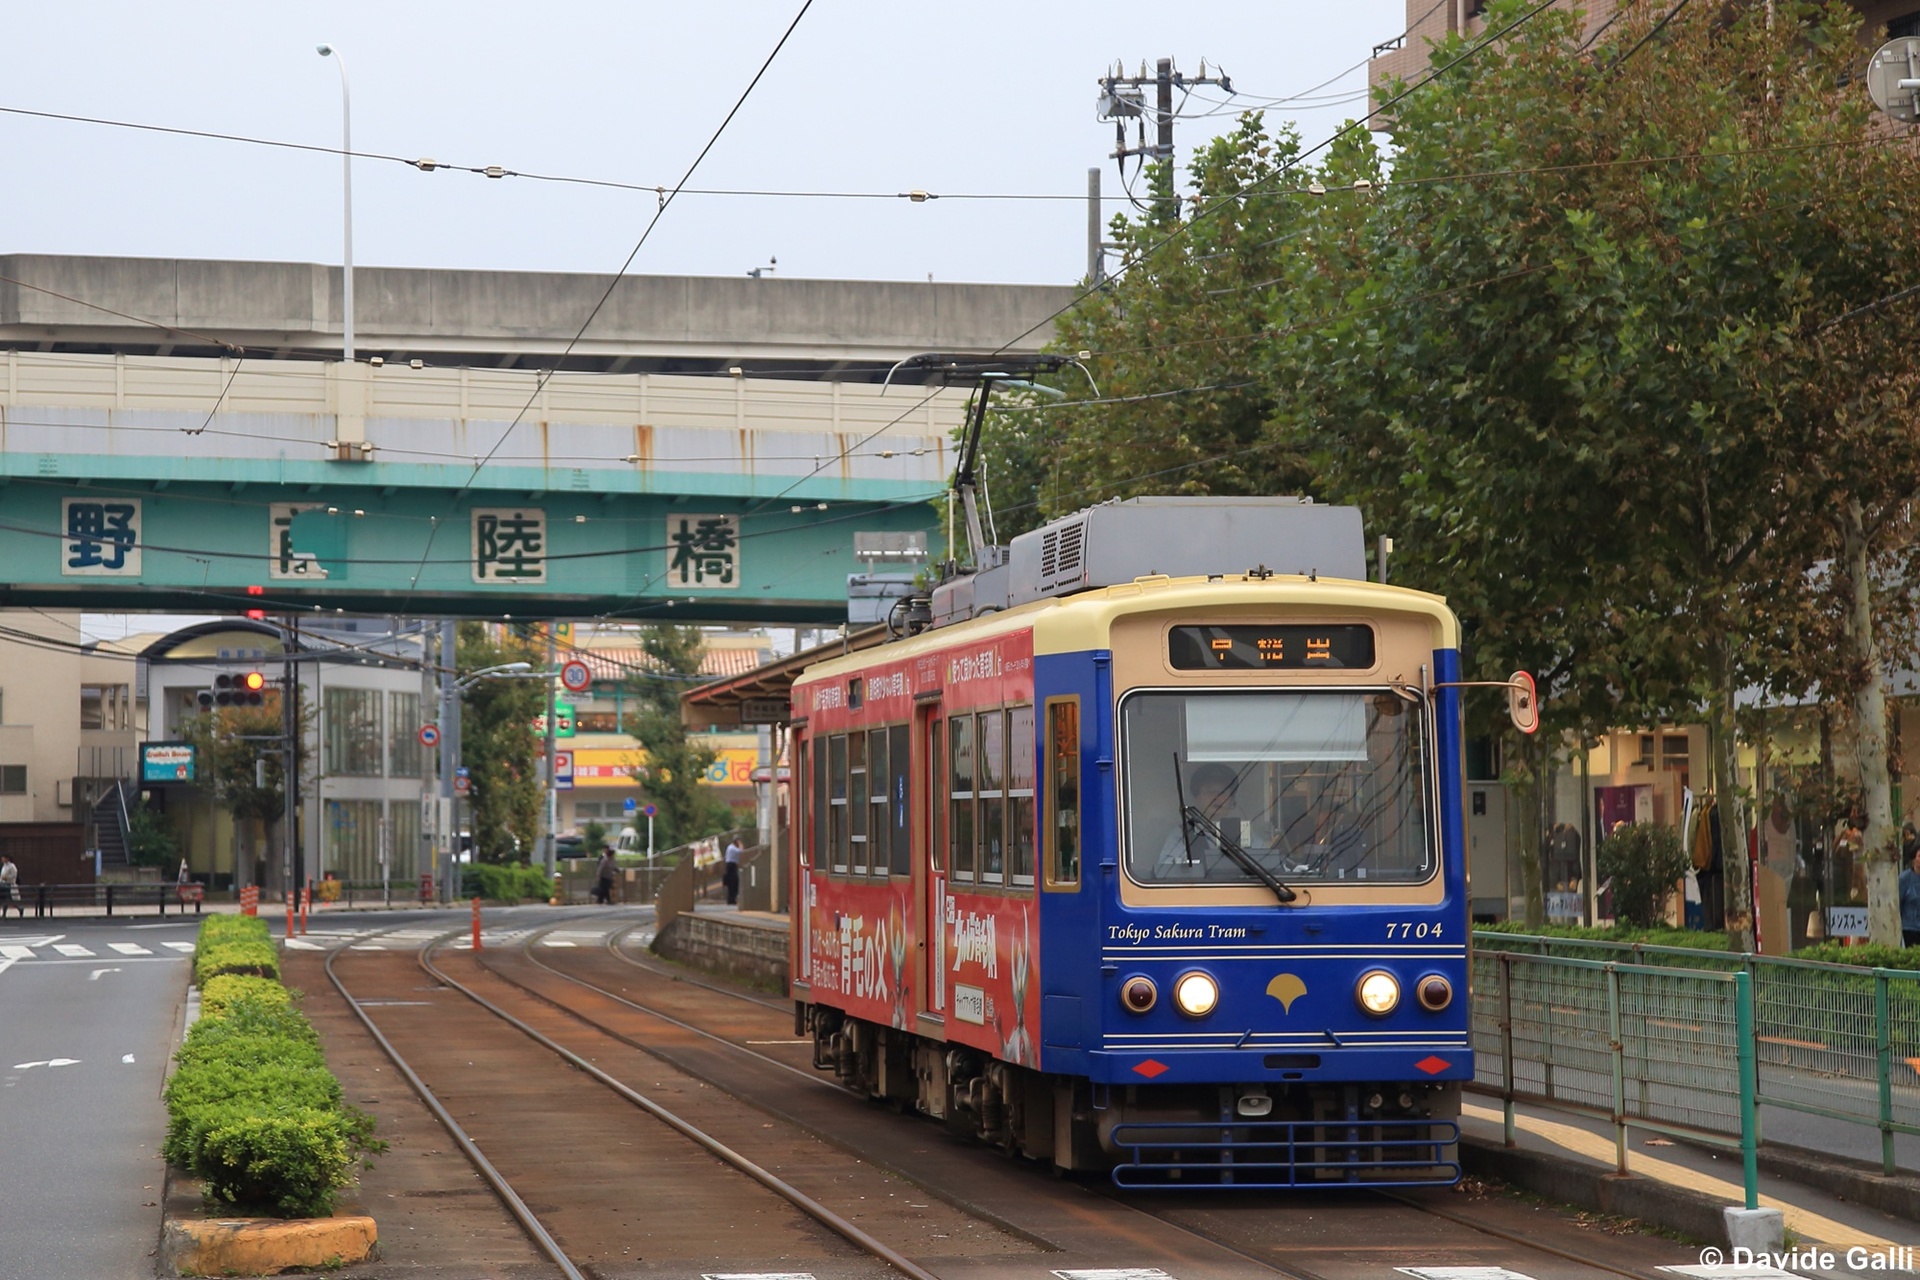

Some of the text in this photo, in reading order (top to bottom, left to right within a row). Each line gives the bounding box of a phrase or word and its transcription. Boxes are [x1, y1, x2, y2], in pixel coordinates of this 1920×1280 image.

[567, 669, 585, 682] 30
[555, 756, 568, 774] P
[1107, 922, 1246, 945] Tokyo Sakura Tram
[1386, 922, 1443, 939] 7704
[840, 912, 888, 1004] 育毛の父
